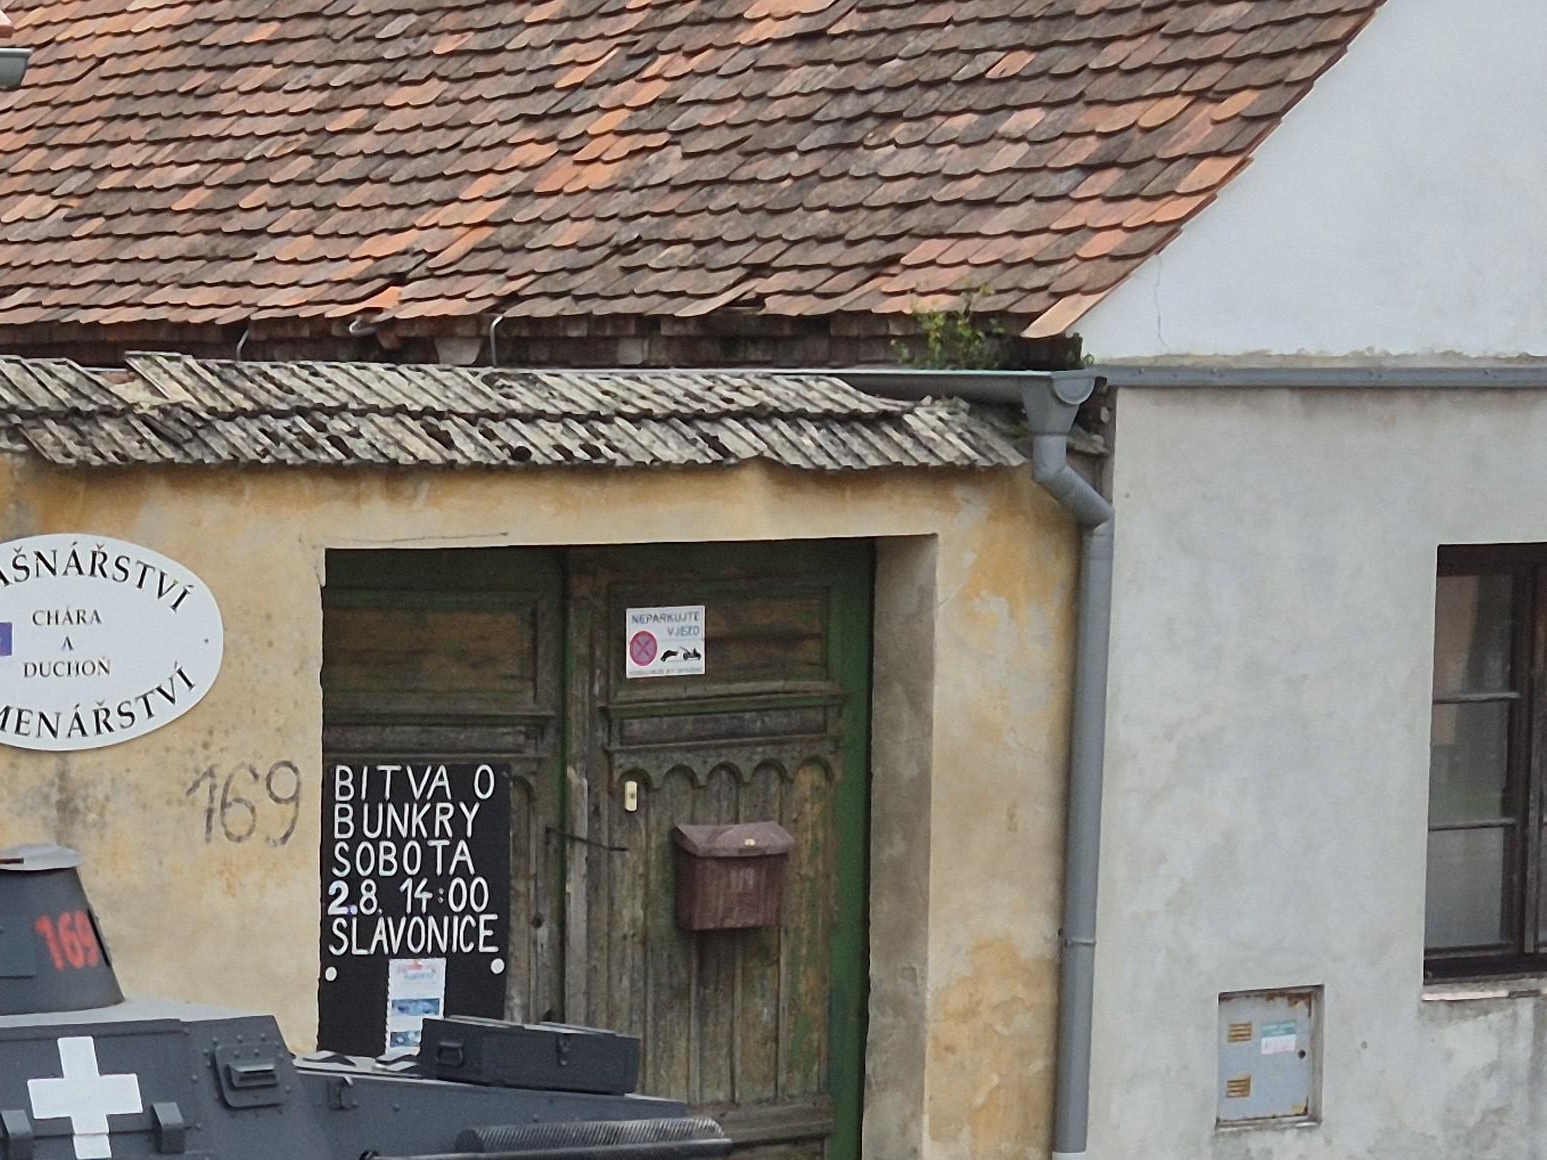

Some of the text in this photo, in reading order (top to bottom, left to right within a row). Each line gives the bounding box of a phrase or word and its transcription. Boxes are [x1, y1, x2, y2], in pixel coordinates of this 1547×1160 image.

[631, 611, 700, 624] NEPARKUJTE
[60, 636, 74, 651] A
[334, 764, 495, 802] BITVA O
[185, 760, 302, 847] 169
[333, 802, 480, 839] BUNKRY
[331, 840, 476, 877] SOBOTA
[399, 877, 489, 914] 14:00
[35, 911, 101, 972] 169
[328, 914, 500, 956] SLAVONICE
